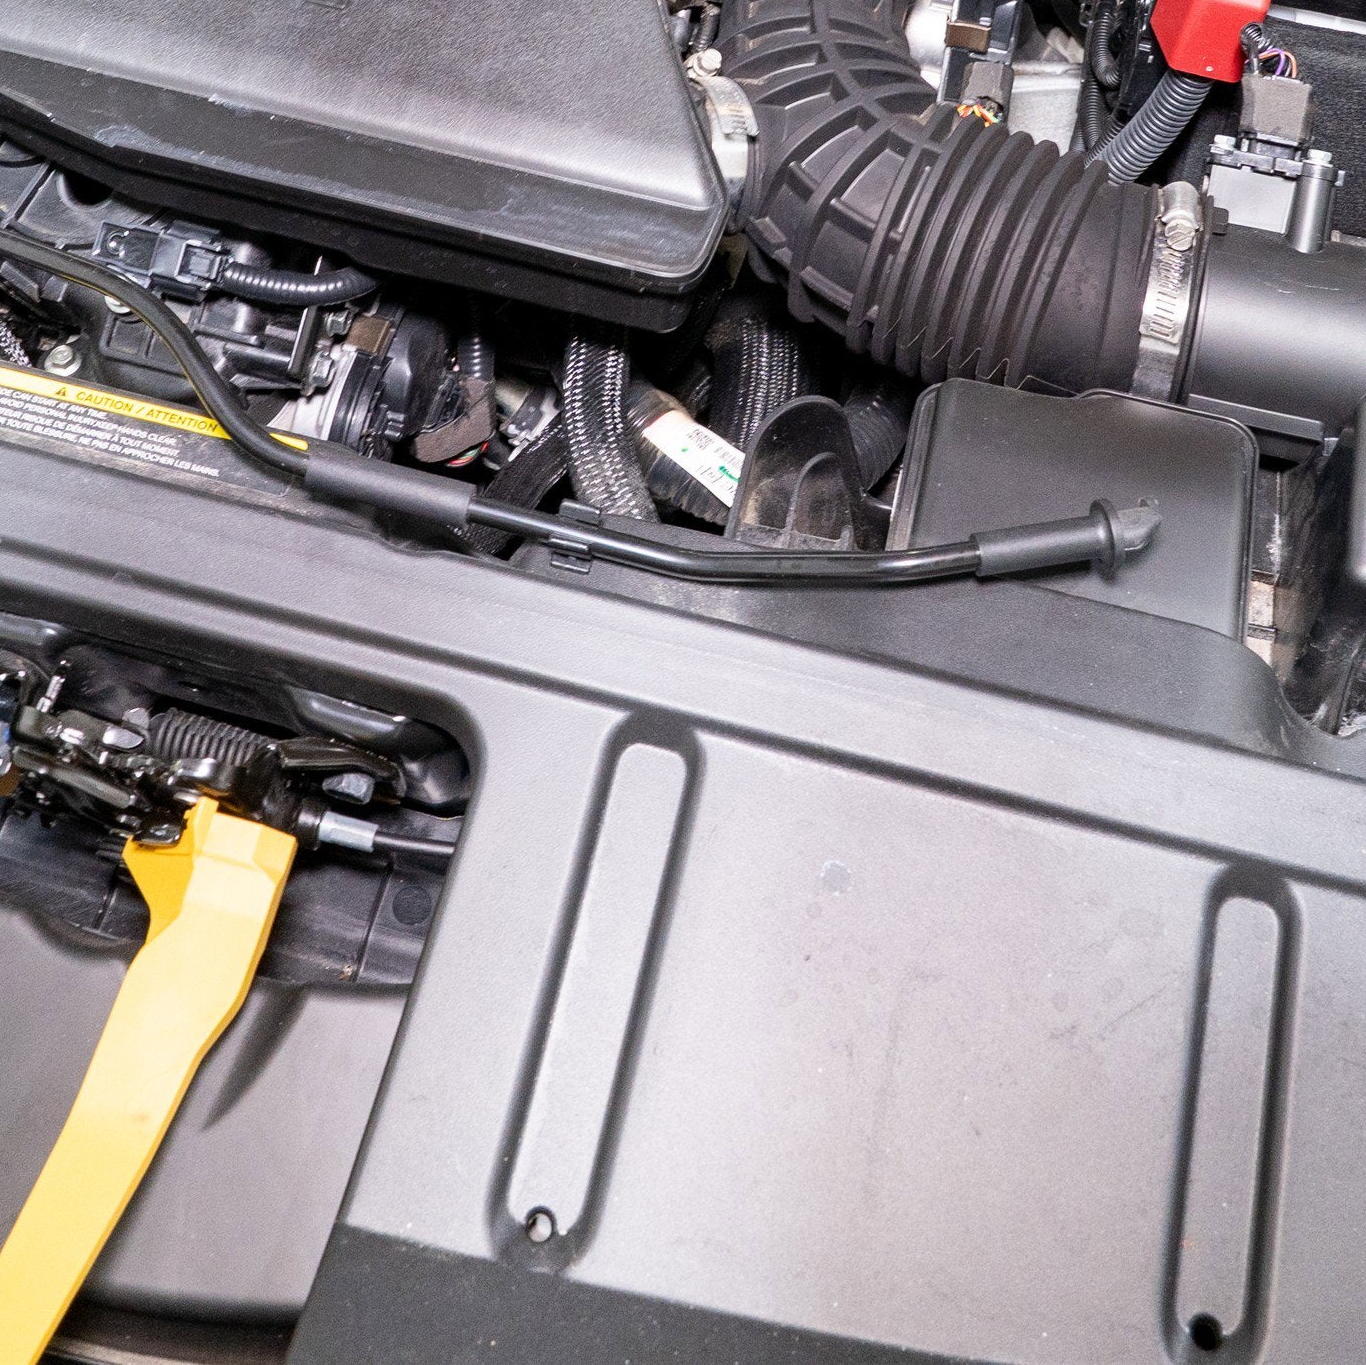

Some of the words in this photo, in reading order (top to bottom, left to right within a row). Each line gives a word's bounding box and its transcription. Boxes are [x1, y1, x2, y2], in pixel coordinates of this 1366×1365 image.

[11, 390, 31, 401] CAN
[31, 395, 55, 408] START
[56, 401, 67, 410] AT
[67, 403, 85, 414] ANY
[76, 391, 134, 412] CAUTION
[145, 409, 218, 432] ATTENTION
[6, 417, 33, 432] TOUTE
[77, 435, 91, 445] NE
[91, 438, 108, 449] PAS
[107, 442, 121, 453] EN
[121, 445, 175, 466] APPROCHER
[173, 458, 191, 470] LES
[21, 411, 53, 427] RISQUE
[53, 419, 65, 429] DE
[119, 435, 142, 448] TOUT
[23, 401, 67, 420] PERSONAL
[117, 424, 147, 439] HANDS
[147, 432, 177, 446] CLEAR.
